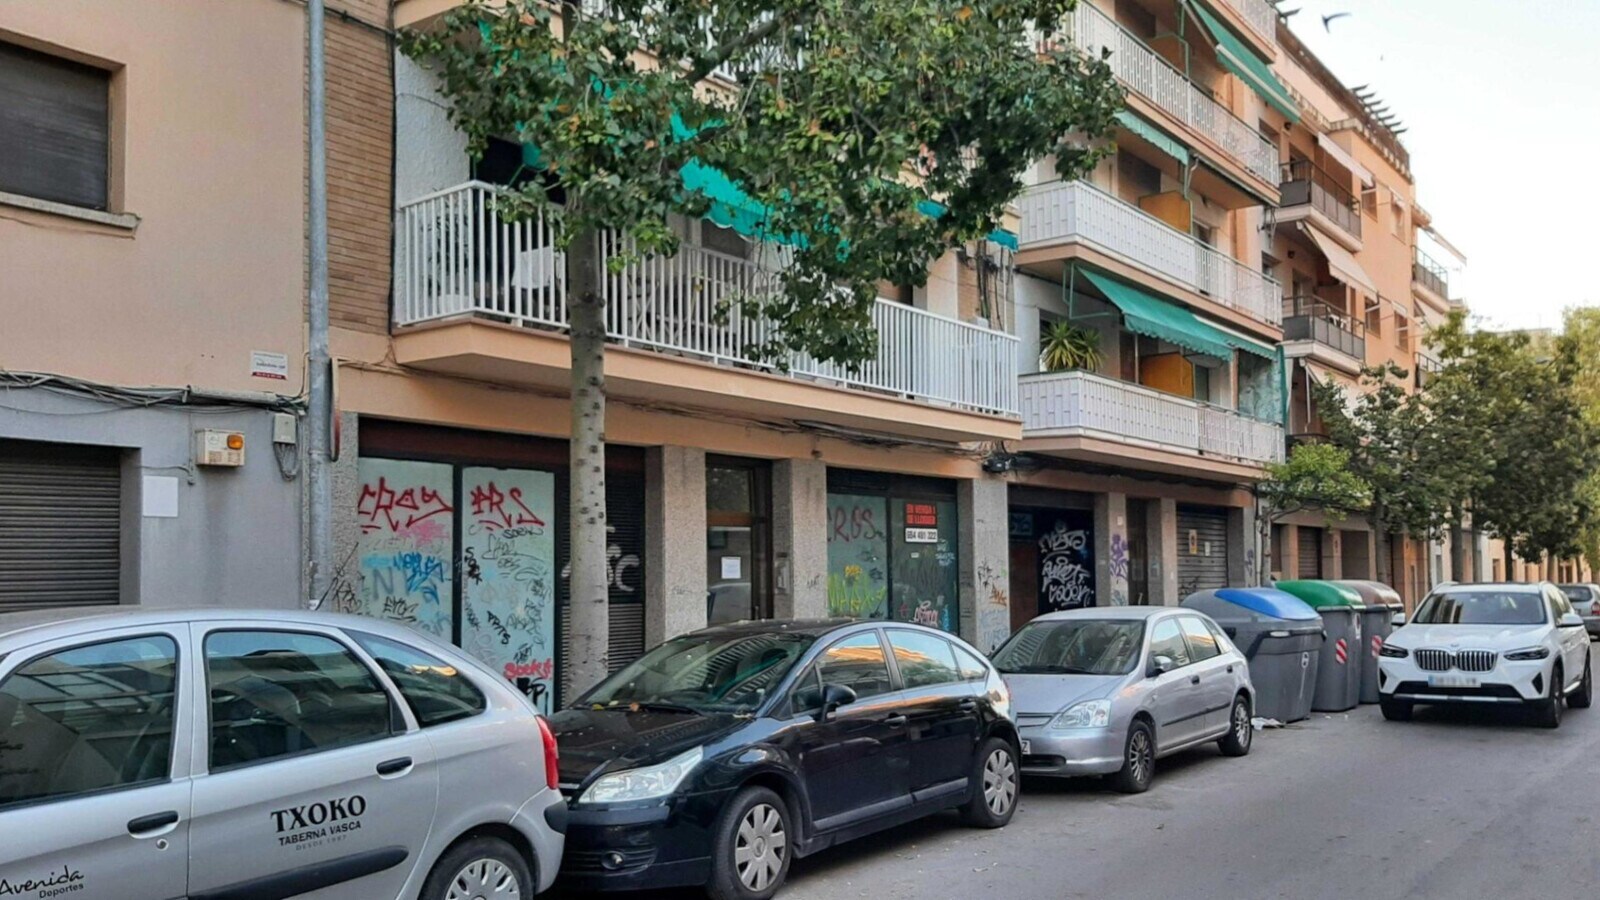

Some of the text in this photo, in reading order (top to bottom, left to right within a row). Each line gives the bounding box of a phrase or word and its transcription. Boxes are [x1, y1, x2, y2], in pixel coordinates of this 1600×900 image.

[270, 795, 366, 833] TXOKO
[278, 820, 361, 846] TABERNA VASCA
[0, 864, 85, 895] Avenida
[39, 883, 84, 899] Deportes
